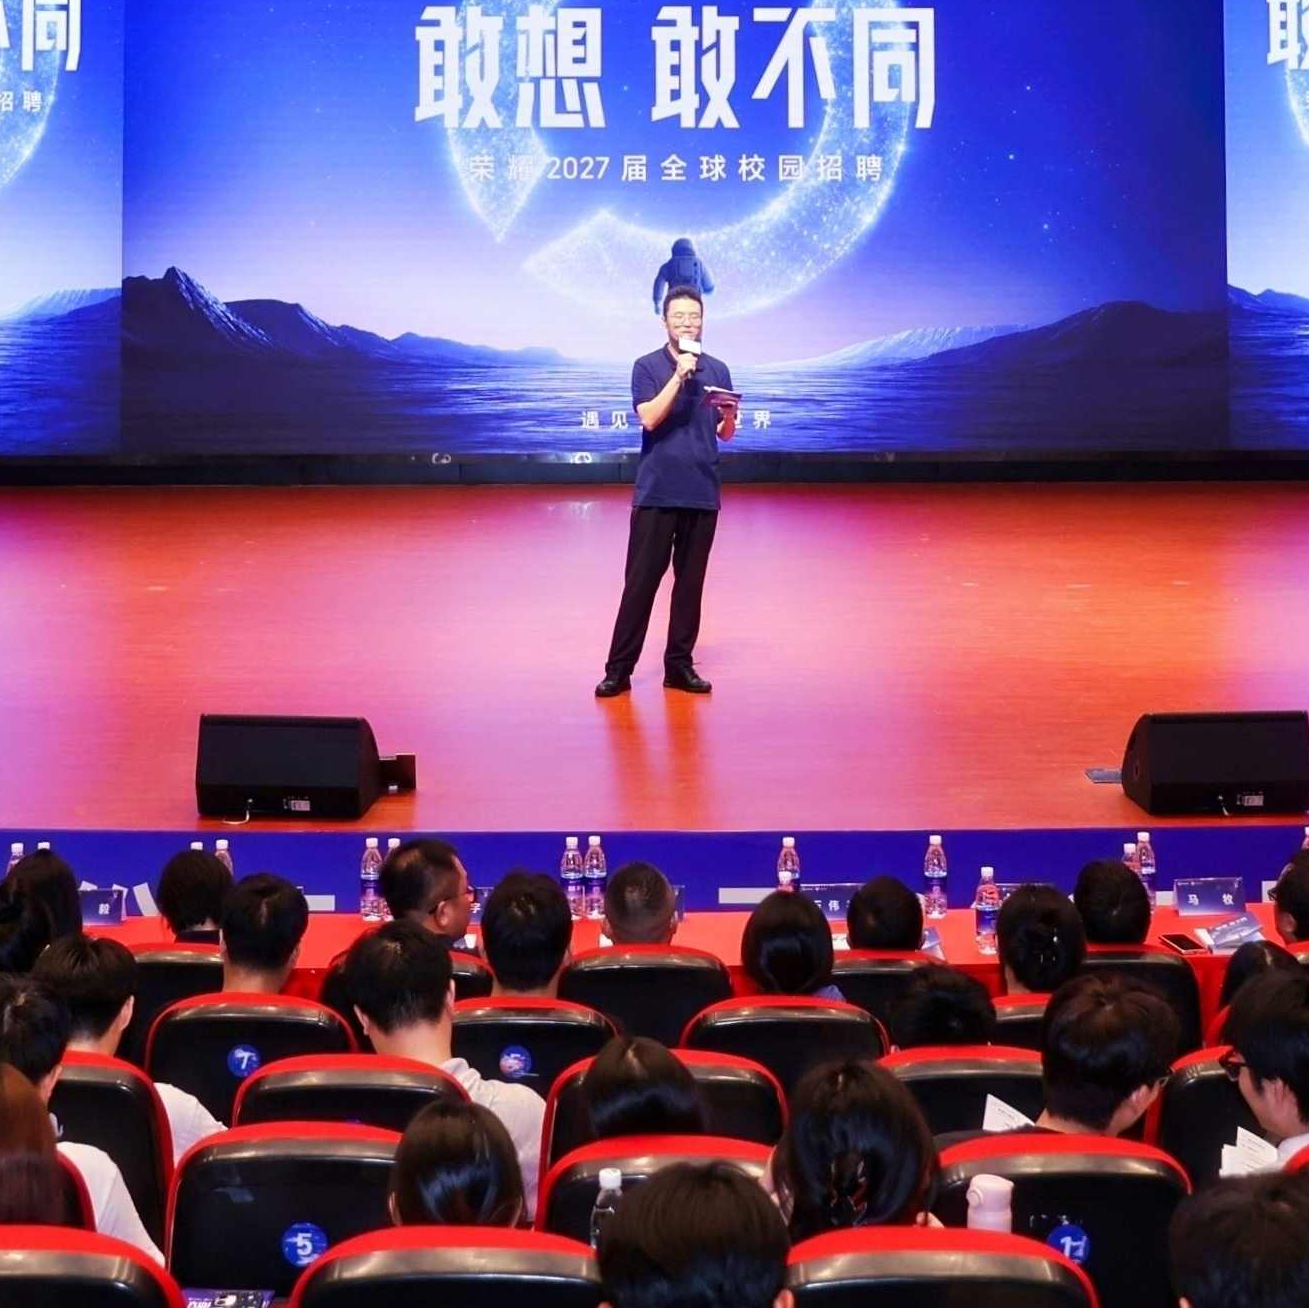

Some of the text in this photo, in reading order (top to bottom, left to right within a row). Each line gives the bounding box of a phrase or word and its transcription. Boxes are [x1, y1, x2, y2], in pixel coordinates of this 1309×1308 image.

[415, 5, 935, 128] 敢想 敢不同
[469, 155, 883, 182] 荣耀2027届全球校园招聘
[297, 1233, 312, 1256] 5
